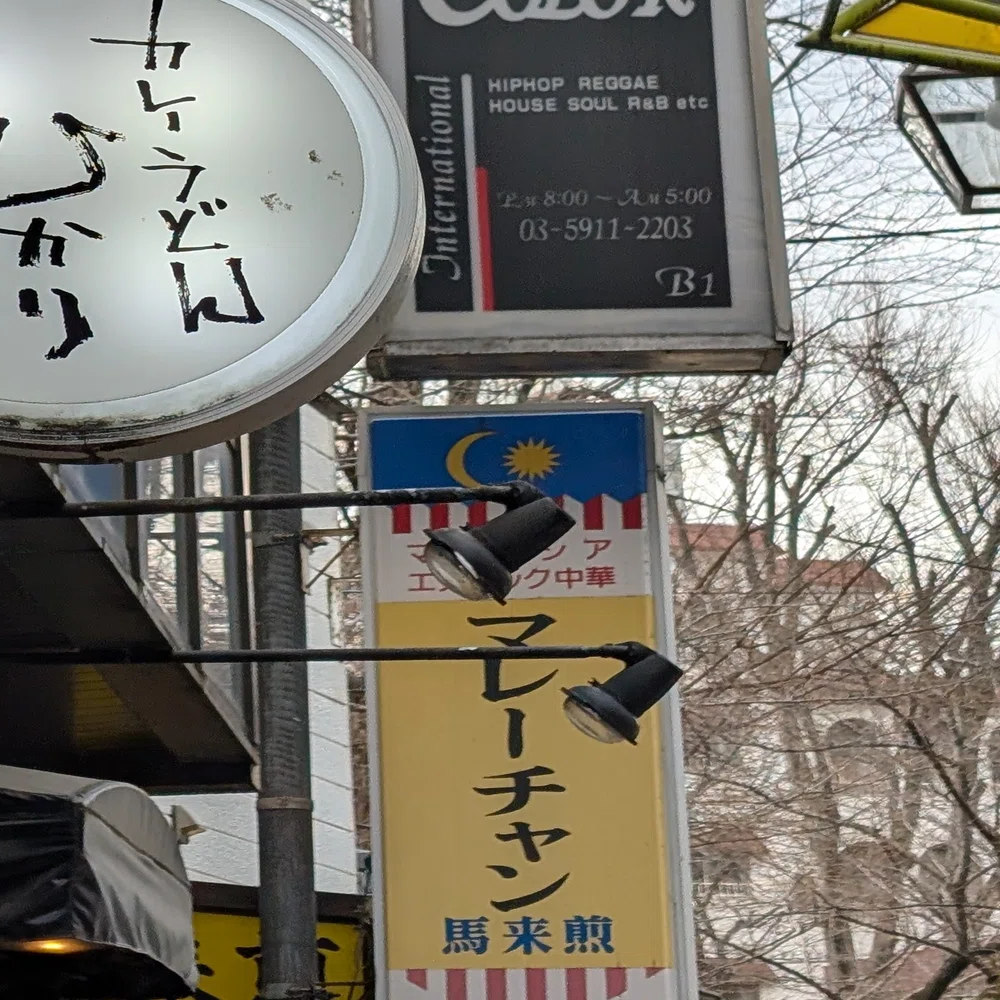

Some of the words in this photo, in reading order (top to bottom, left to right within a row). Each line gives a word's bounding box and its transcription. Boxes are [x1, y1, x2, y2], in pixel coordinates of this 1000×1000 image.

[488, 76, 565, 93] HIPHOP
[578, 75, 660, 91] REGGAE
[489, 98, 558, 113] HOUSE
[567, 97, 619, 112] SOUL
[627, 95, 669, 111] R&B
[677, 96, 710, 110] etc
[414, 74, 463, 281] International
[543, 189, 589, 207] 8:00
[664, 187, 713, 205] 5:00
[519, 215, 694, 242] 03-5911-2203
[467, 612, 571, 913] マレーチャン
[441, 915, 615, 956] 馬来煎
